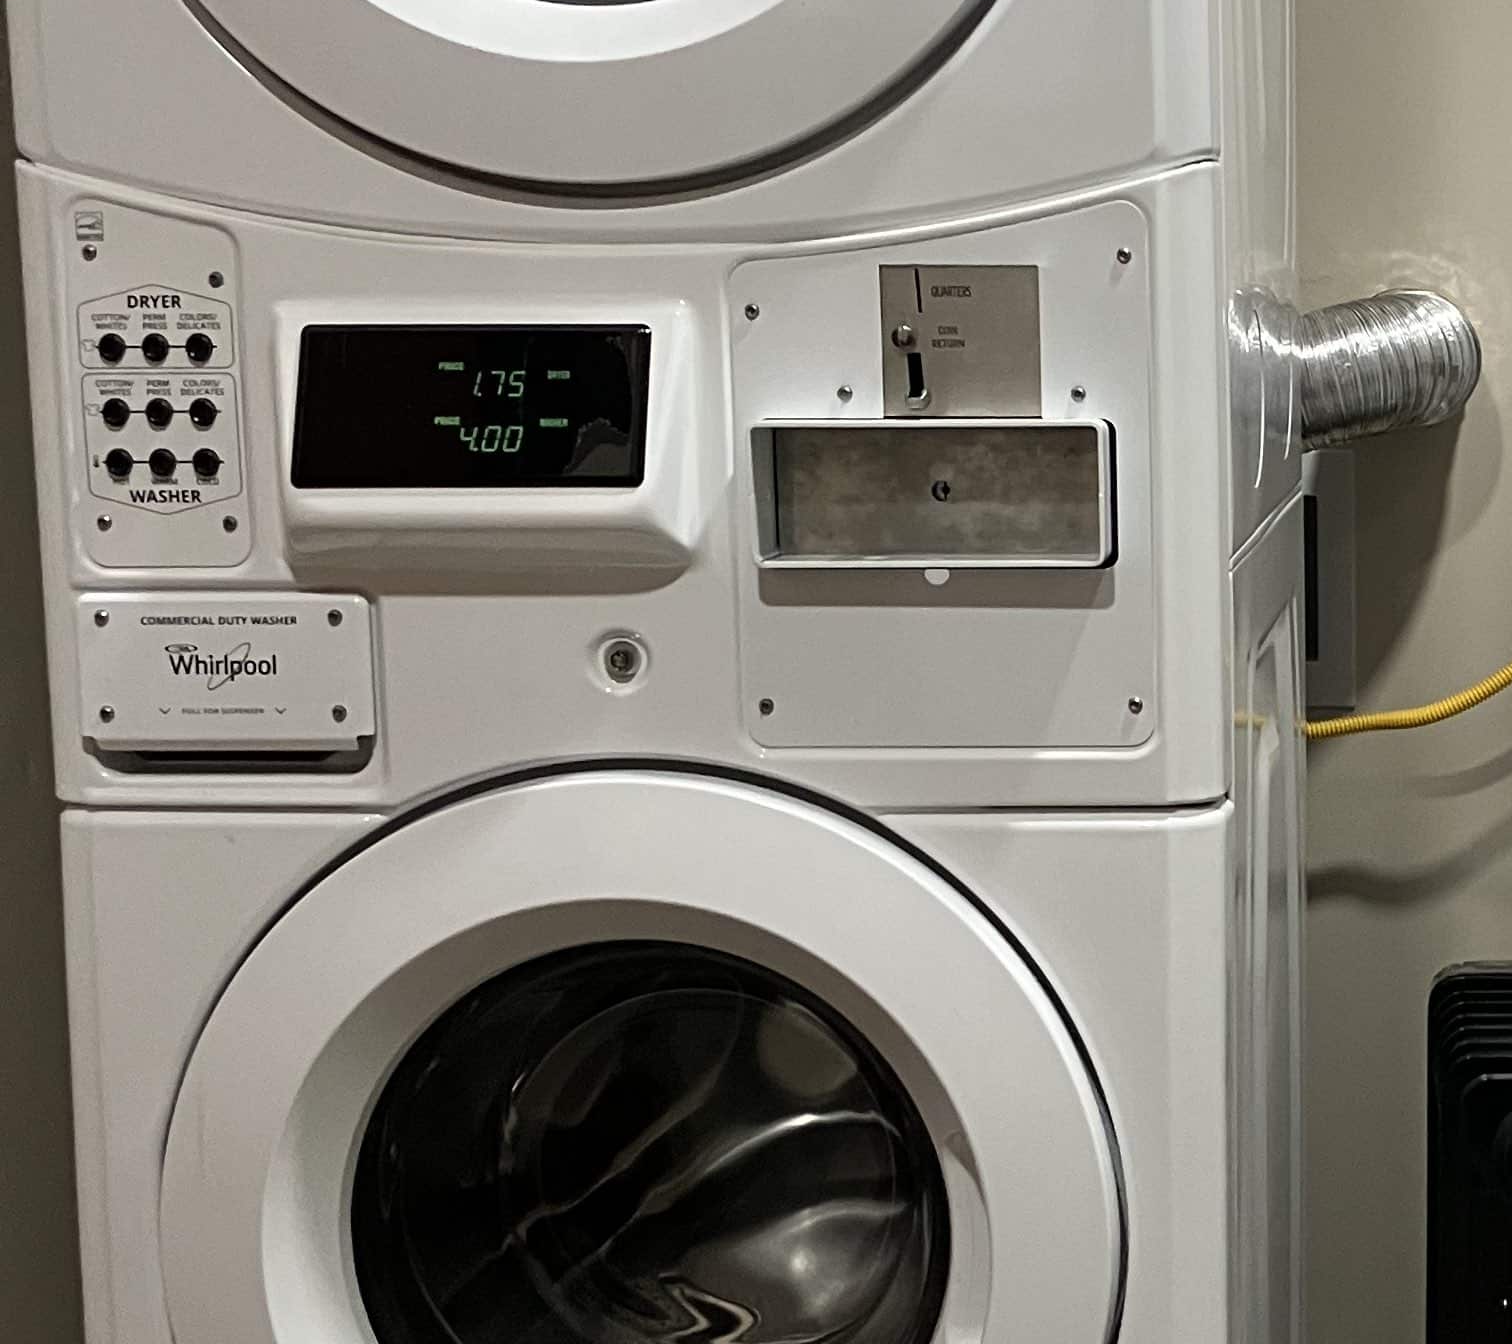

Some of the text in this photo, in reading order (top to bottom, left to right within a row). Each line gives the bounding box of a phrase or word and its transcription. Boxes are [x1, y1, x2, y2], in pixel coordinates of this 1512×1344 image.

[930, 285, 972, 298] QUARTERS
[126, 294, 181, 309] DRYER
[473, 370, 527, 397] 1.75
[459, 425, 524, 452] 4.00
[129, 489, 202, 504] WASHER
[140, 616, 297, 626] COMMERCIAL DUTY WASHER
[168, 653, 277, 682] Whirlpool
